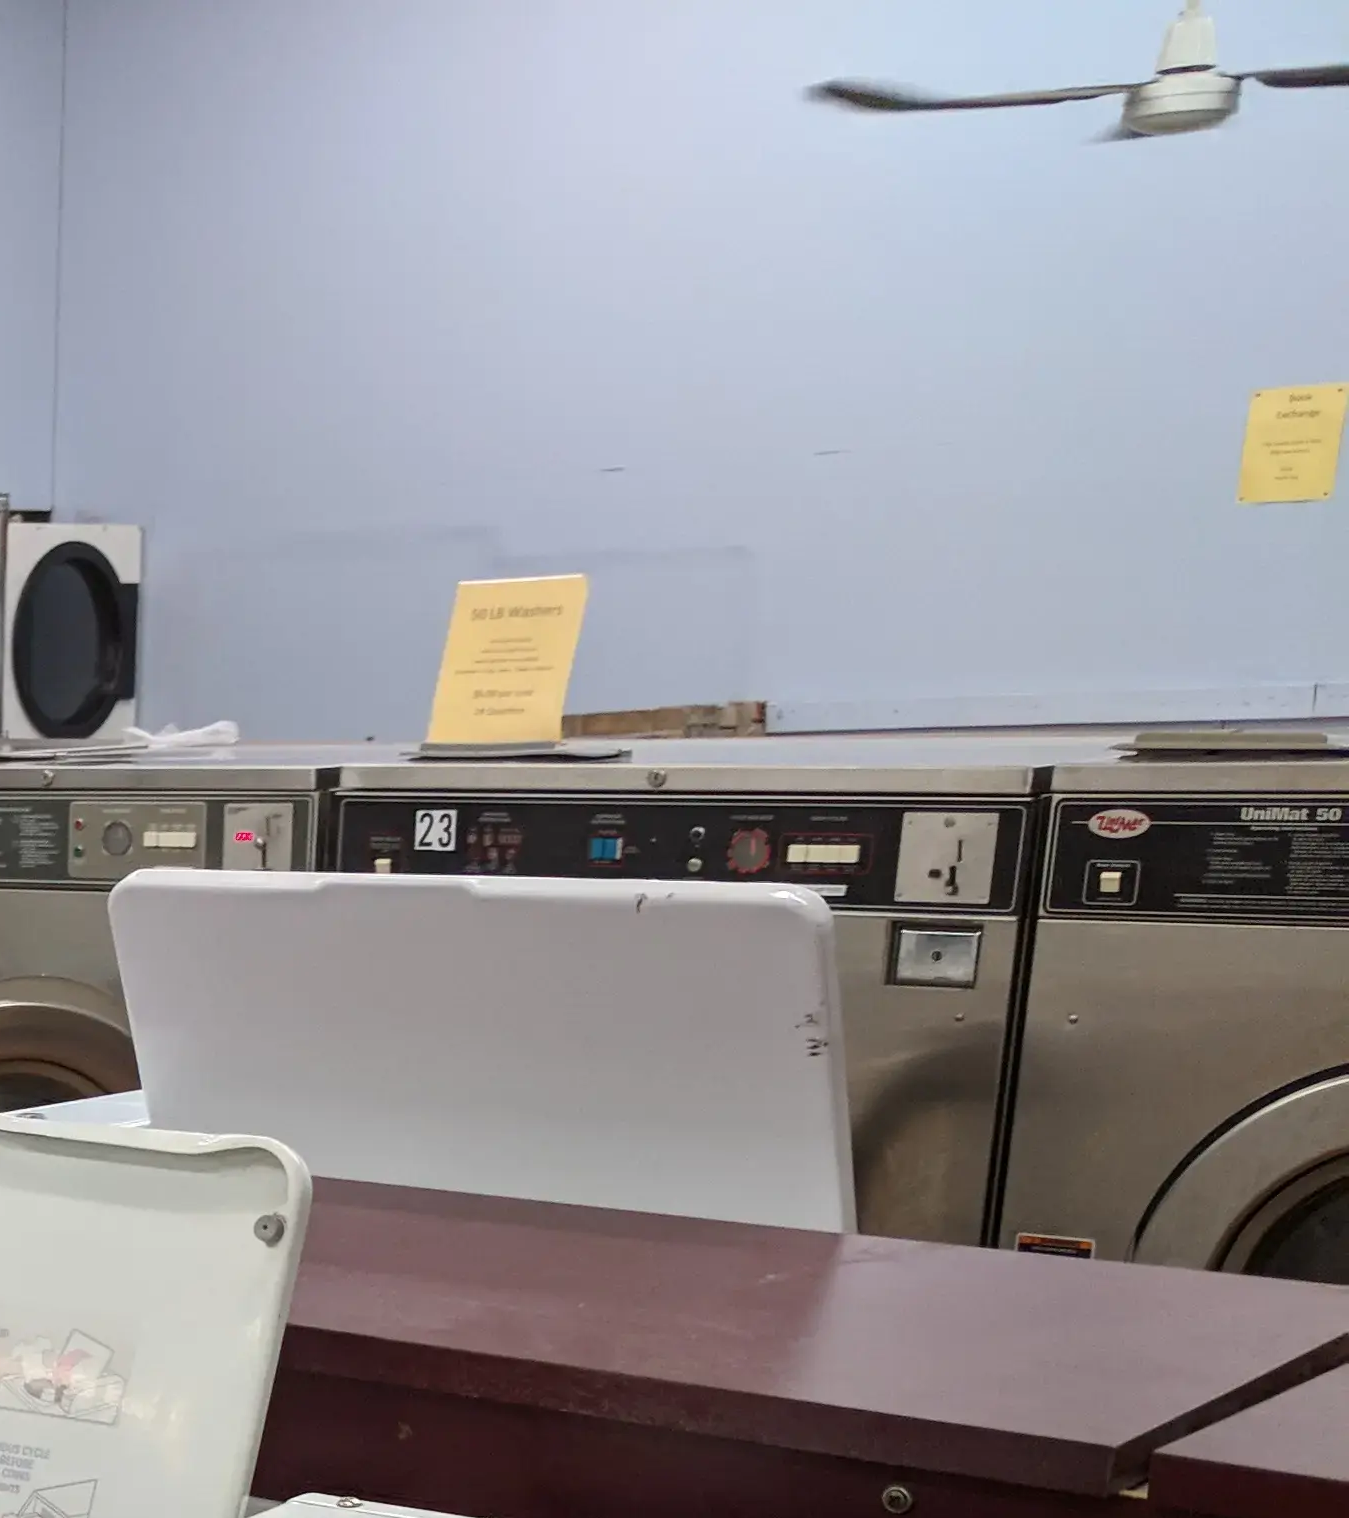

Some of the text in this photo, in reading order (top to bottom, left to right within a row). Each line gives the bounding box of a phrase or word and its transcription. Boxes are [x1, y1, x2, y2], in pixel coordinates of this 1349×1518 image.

[508, 605, 564, 619] Washers
[1241, 807, 1342, 821] UniMat 50
[419, 811, 453, 849] 23
